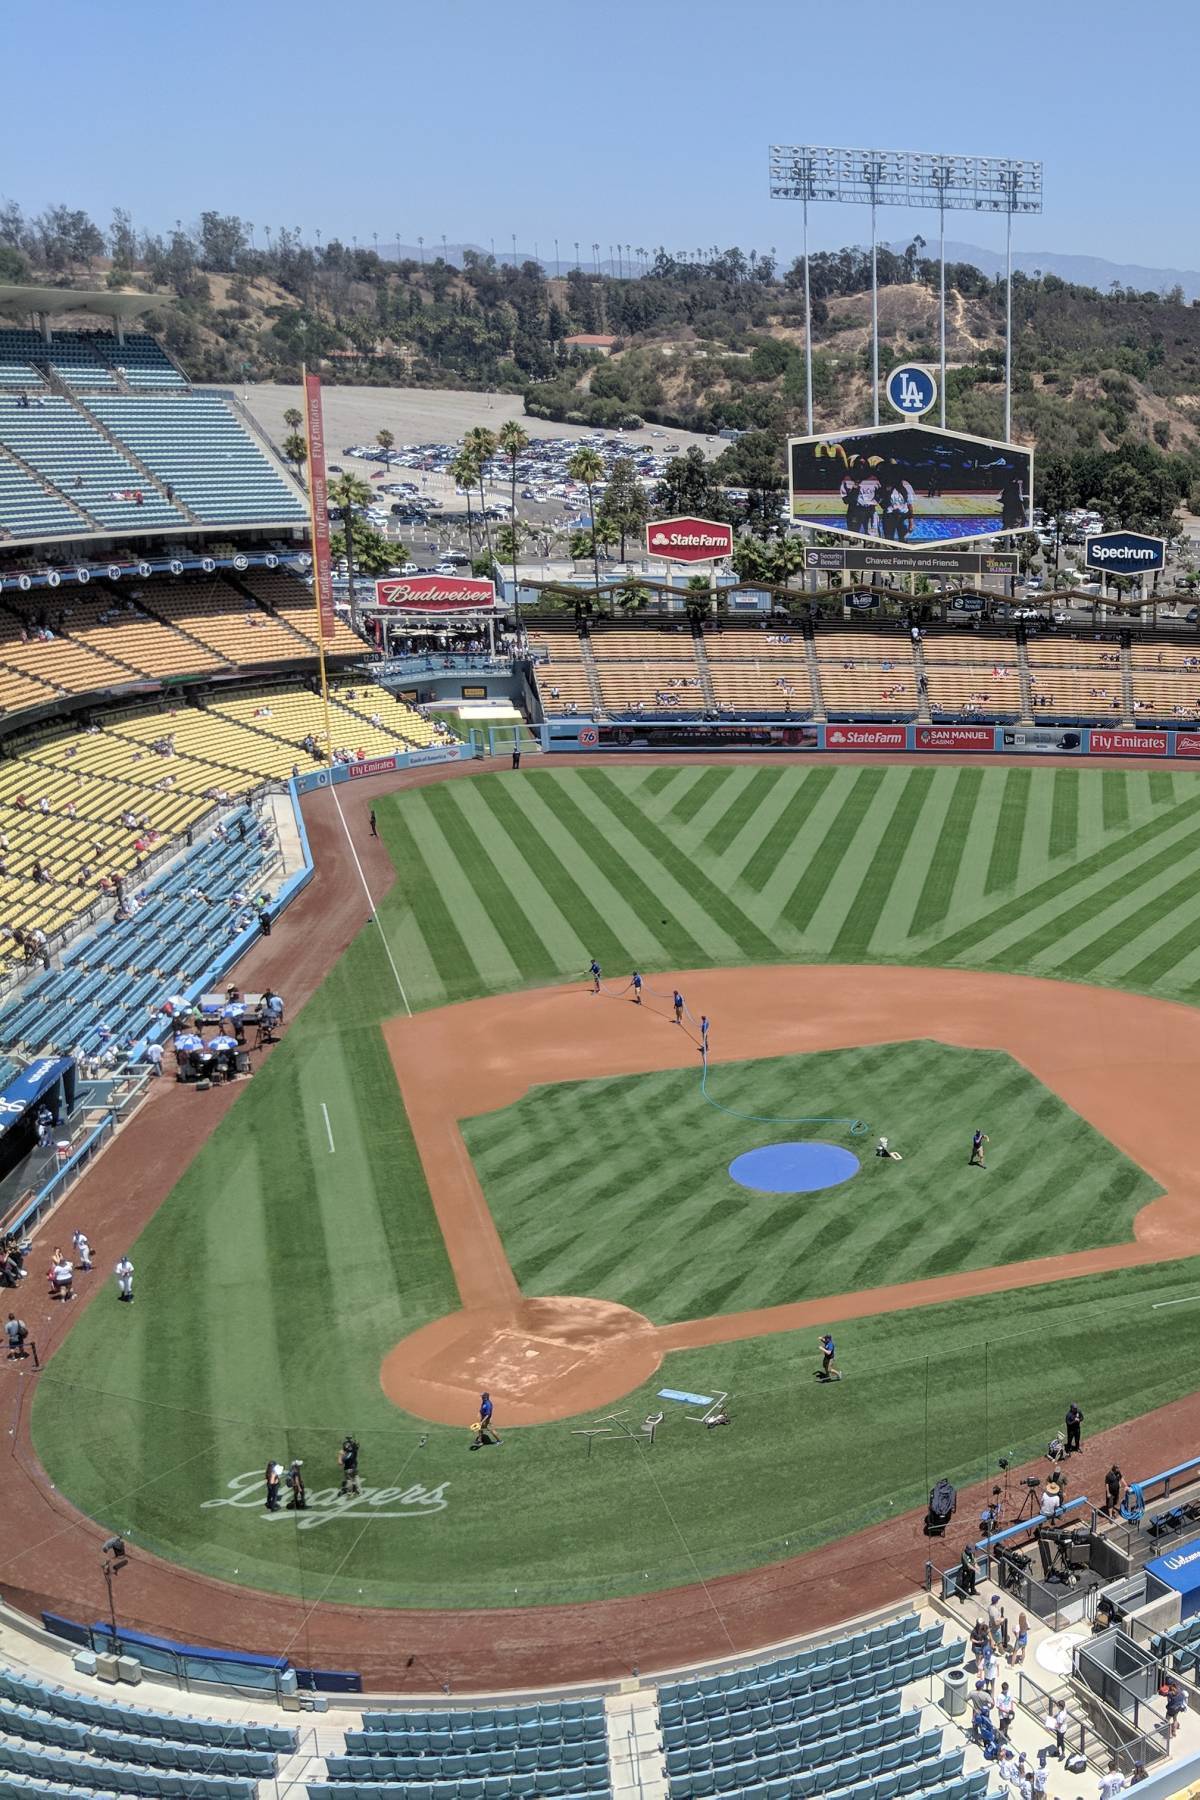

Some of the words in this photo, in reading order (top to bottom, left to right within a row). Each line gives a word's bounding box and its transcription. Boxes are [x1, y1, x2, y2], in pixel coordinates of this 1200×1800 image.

[899, 373, 924, 408] LA
[820, 553, 843, 562] Security
[1092, 545, 1154, 560] Spectrum
[865, 556, 892, 565] Chavez
[892, 557, 917, 567] Family
[917, 558, 932, 566] and
[932, 558, 959, 567] Friends
[382, 585, 492, 603] Budweiser
[583, 731, 595, 742] 76
[931, 731, 949, 739] SAN
[951, 731, 989, 740] MANUEL
[1093, 736, 1110, 748] Fly
[1114, 735, 1165, 748] Emirates
[352, 765, 363, 776] Fly
[364, 760, 394, 773] Emirates
